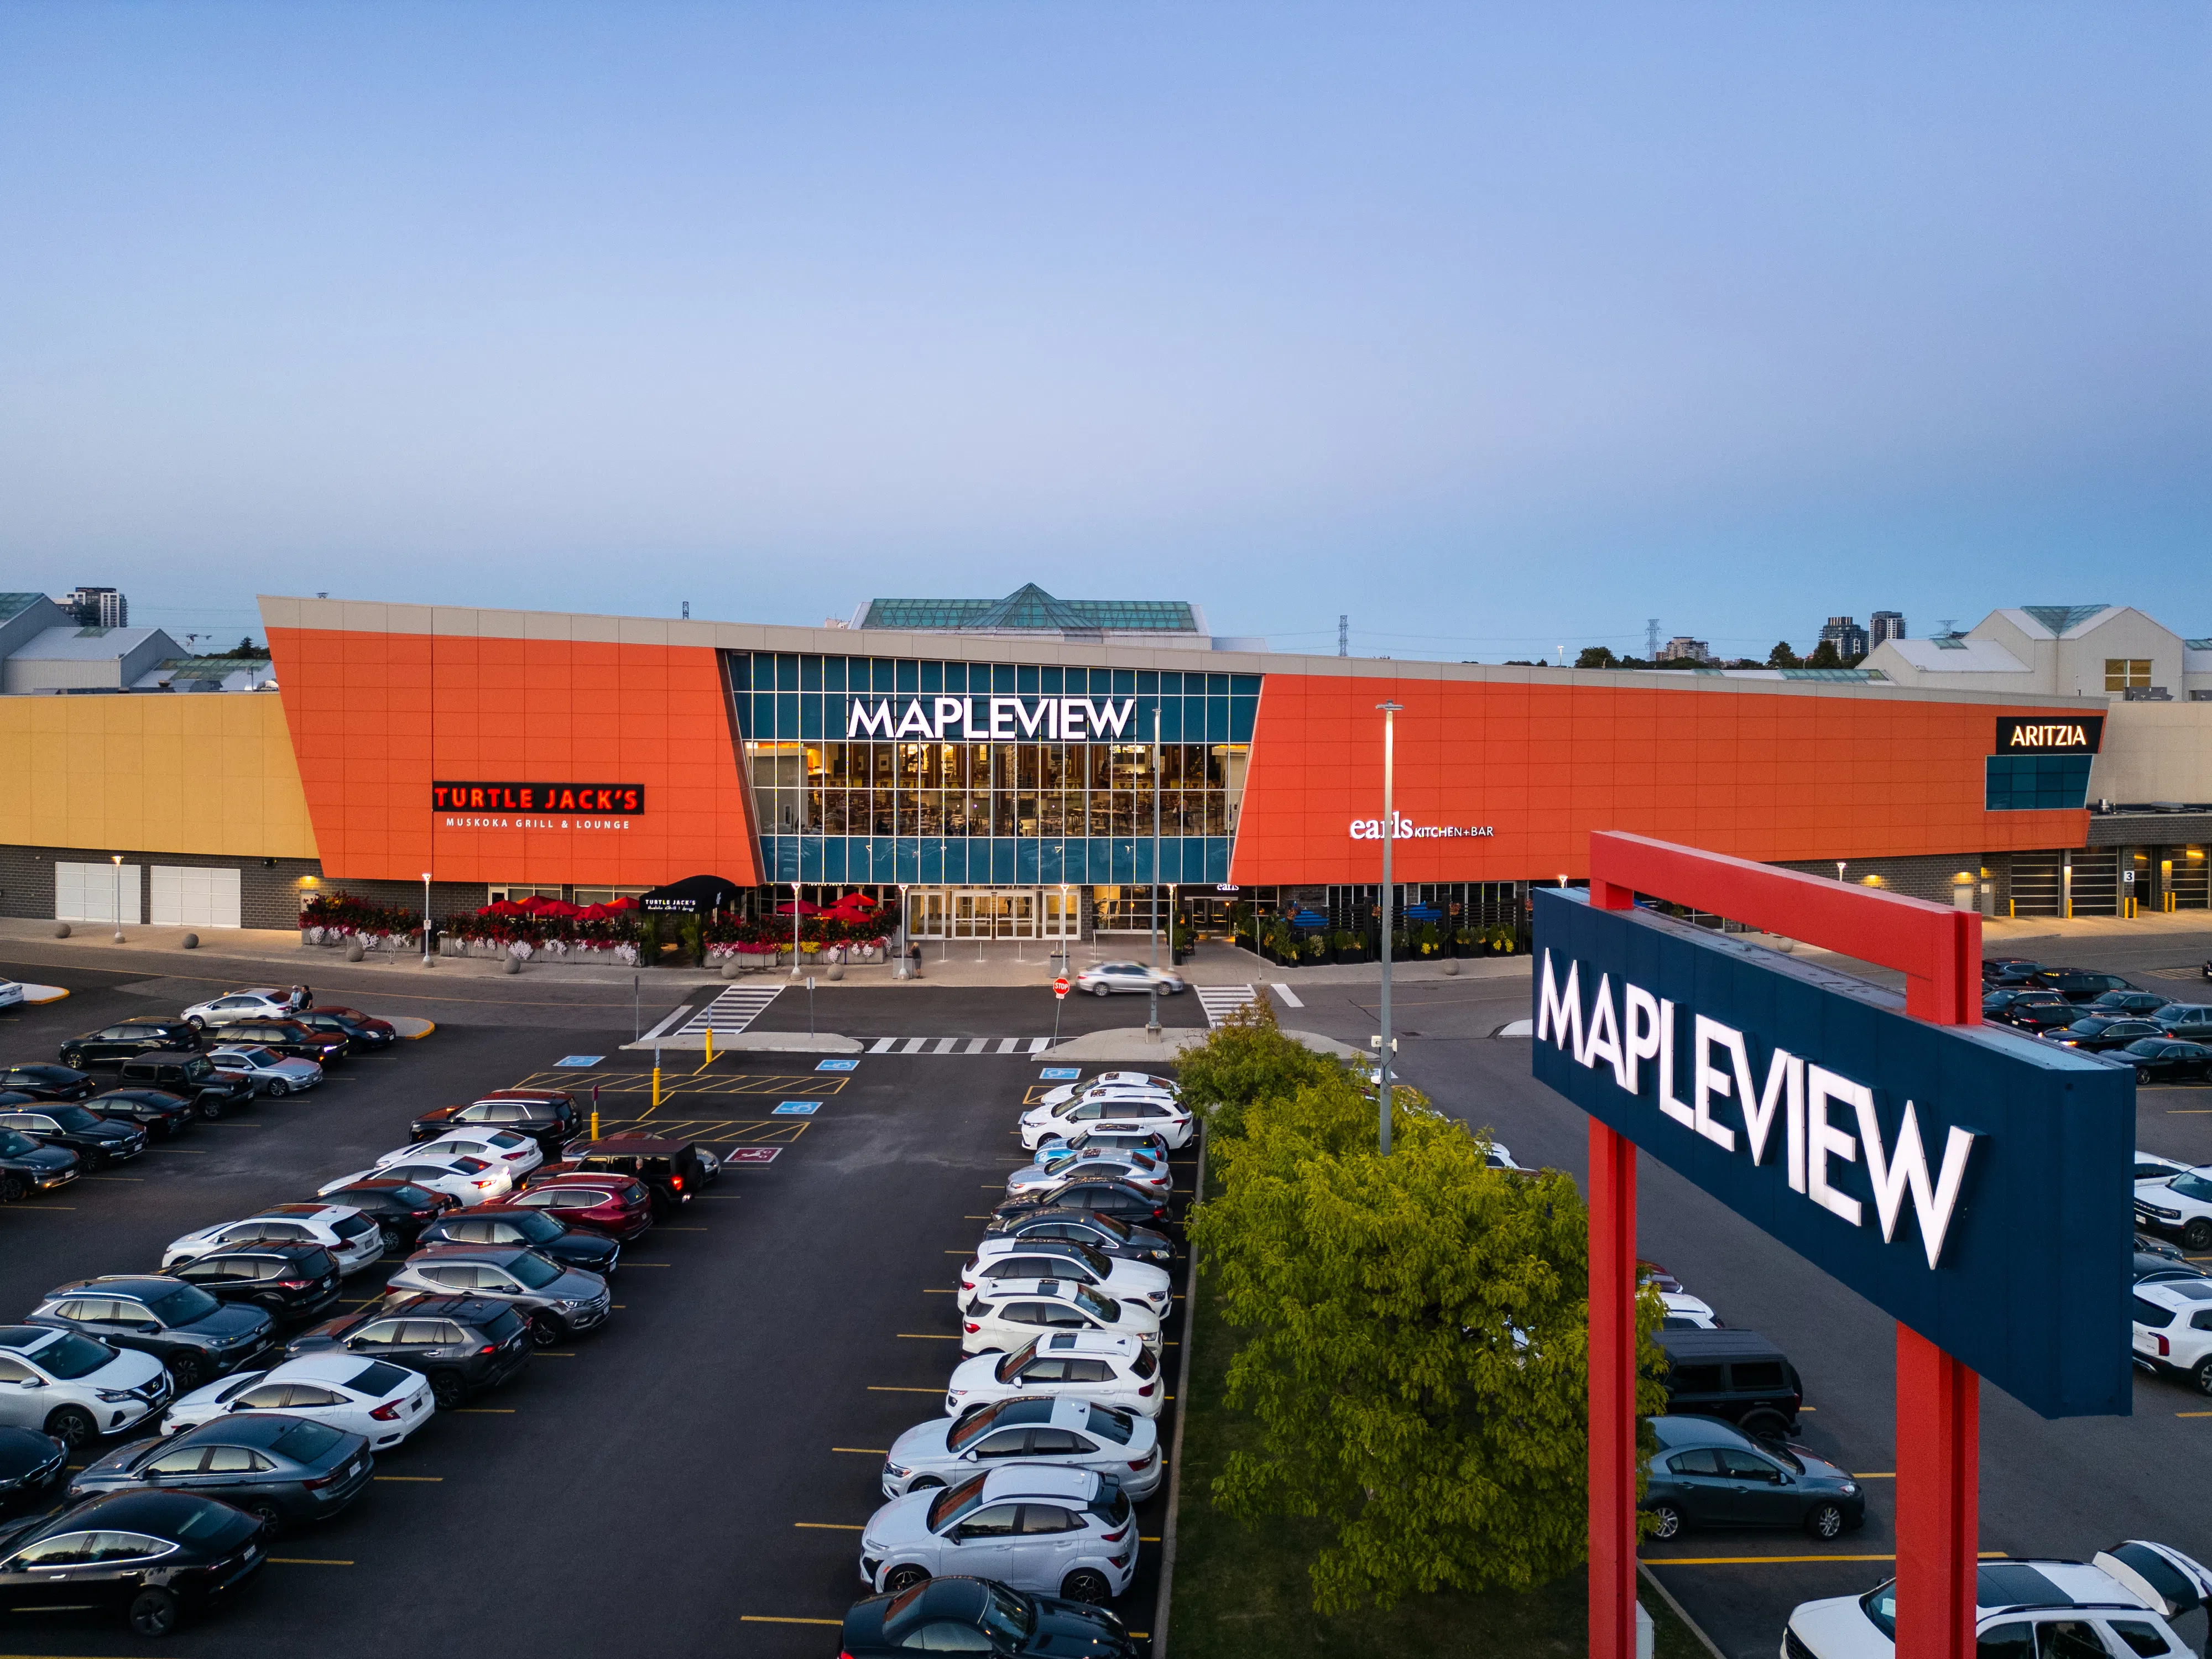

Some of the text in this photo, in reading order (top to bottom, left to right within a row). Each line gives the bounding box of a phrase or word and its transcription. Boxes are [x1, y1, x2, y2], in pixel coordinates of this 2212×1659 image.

[848, 697, 1135, 739] MAPLEVIEW
[2011, 726, 2086, 746] ARITZIA
[434, 787, 638, 810] TURTLE JACK'S
[446, 818, 629, 829] MUSKOKA GRILL & LOUNGE
[1415, 827, 1494, 838] KITCHEN+BAR
[2126, 872, 2133, 881] 3
[1055, 982, 1068, 990] STOP
[1538, 947, 1975, 1270] MAPLEVIEW
